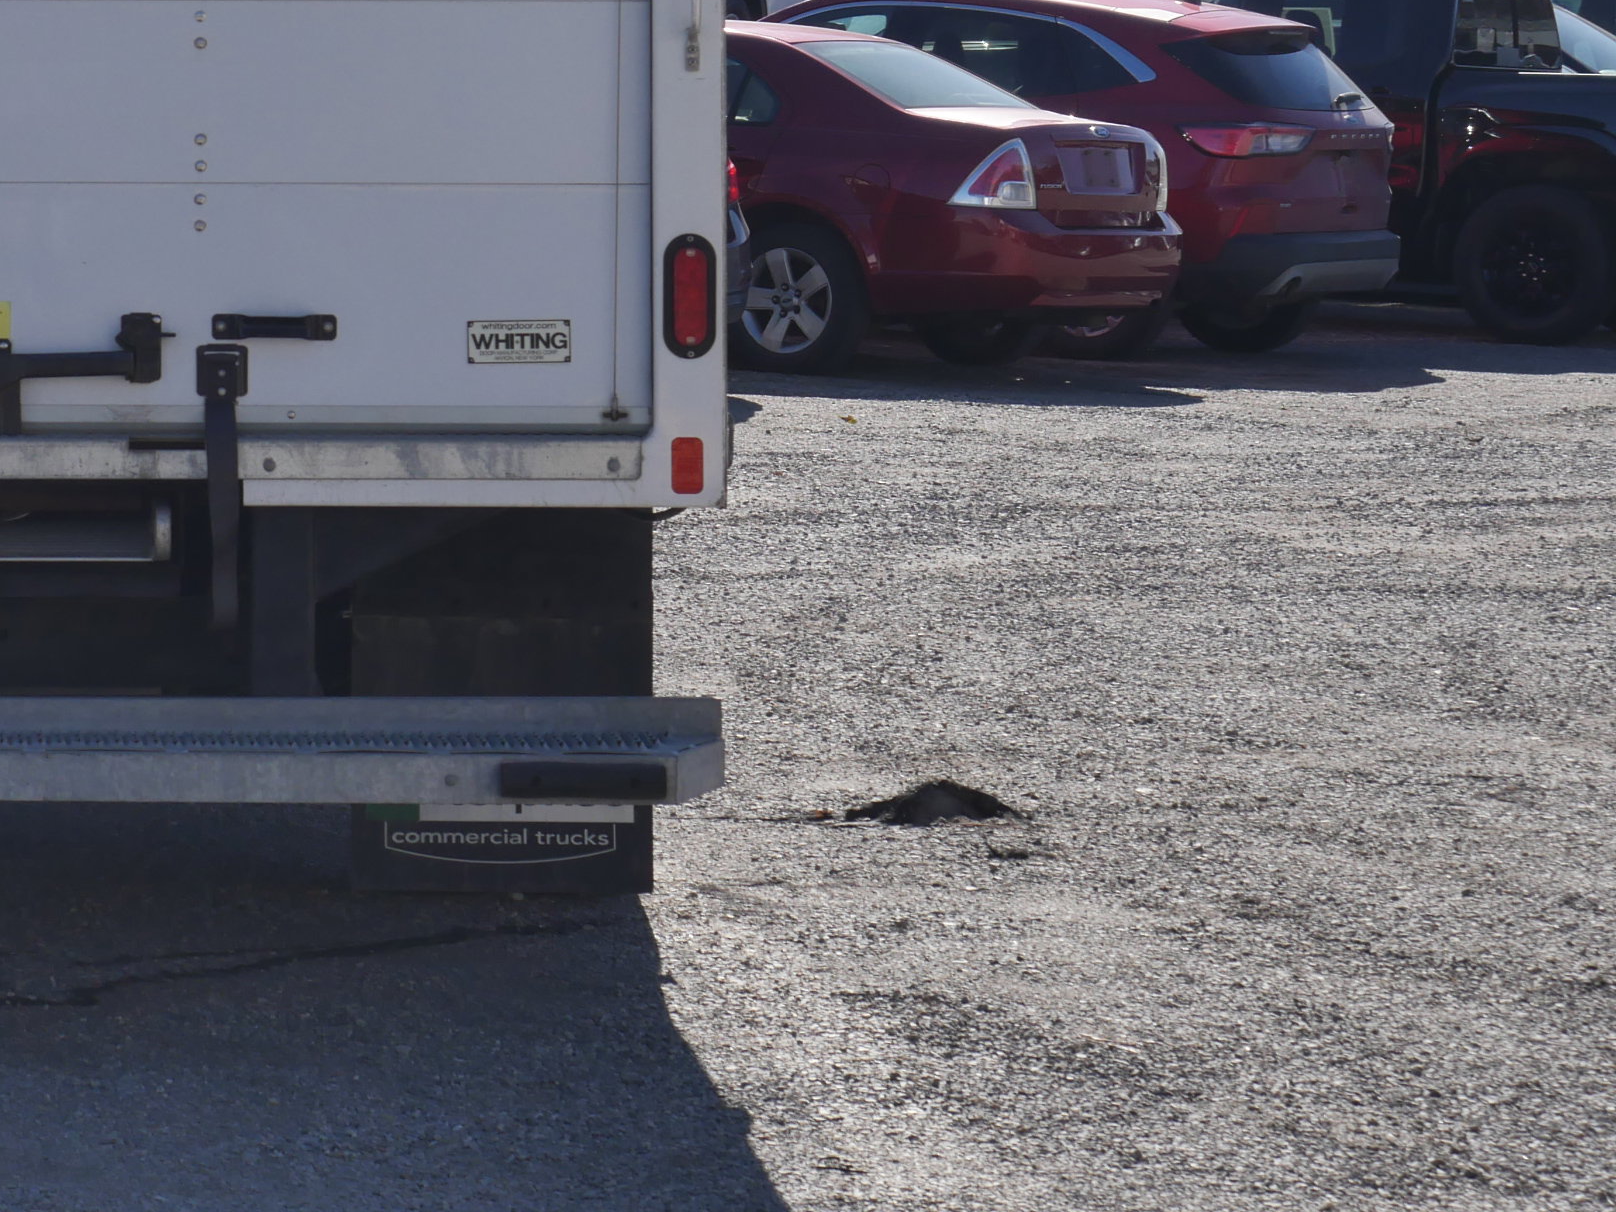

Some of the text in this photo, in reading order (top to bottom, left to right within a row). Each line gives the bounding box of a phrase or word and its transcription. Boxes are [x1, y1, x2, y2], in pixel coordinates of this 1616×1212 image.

[481, 322, 557, 331] whitingdoor.com
[471, 332, 568, 350] WHITING
[391, 827, 610, 846] commercial trucks
